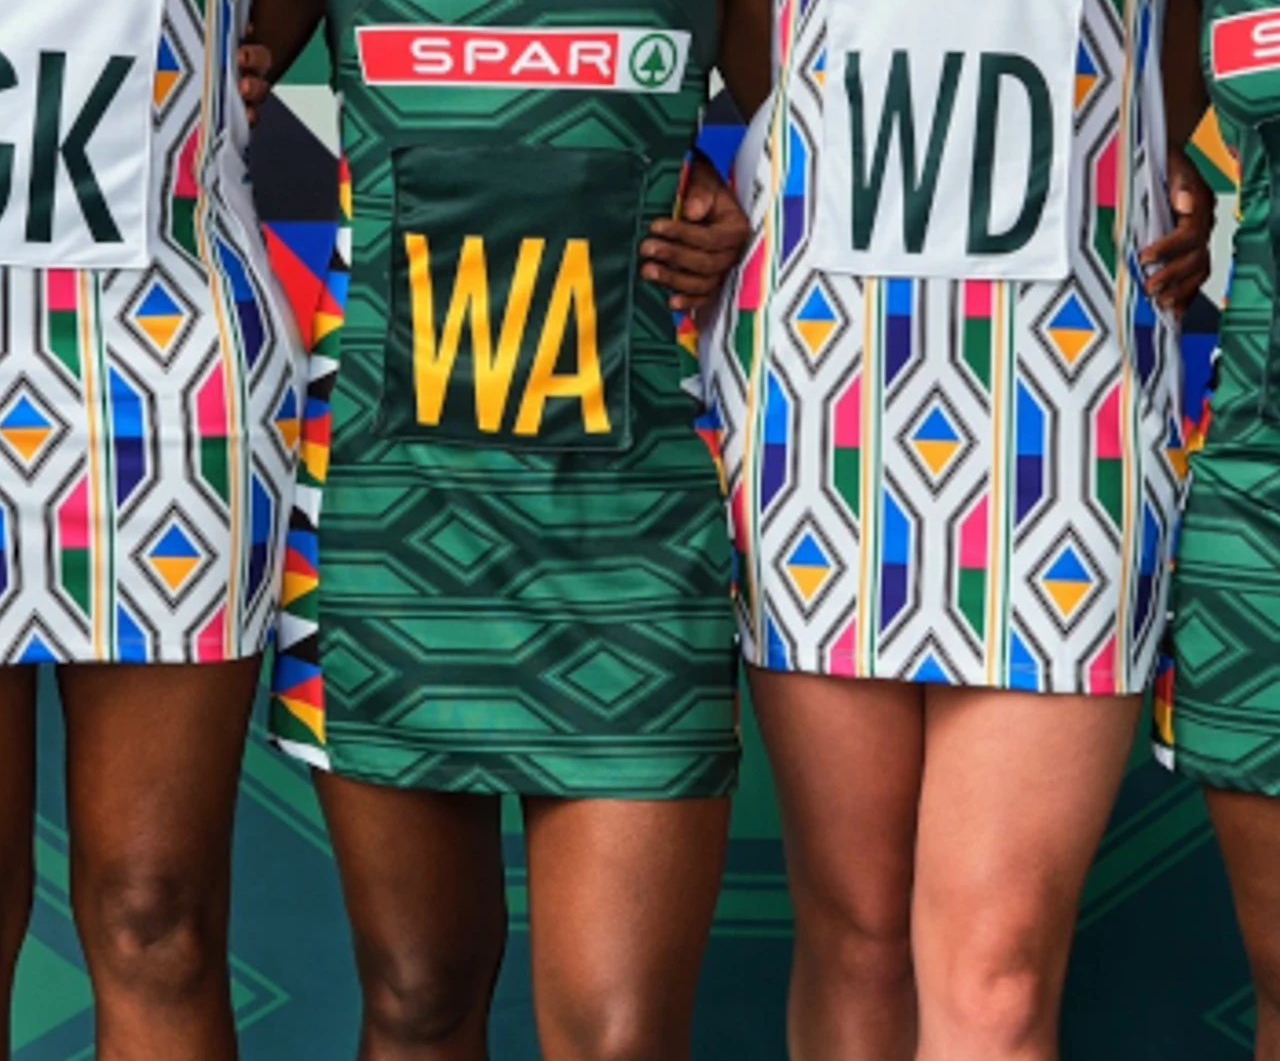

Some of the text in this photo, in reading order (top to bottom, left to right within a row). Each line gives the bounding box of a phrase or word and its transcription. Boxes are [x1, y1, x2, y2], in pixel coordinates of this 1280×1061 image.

[411, 37, 611, 76] SPAR
[844, 50, 1054, 256] WD
[404, 232, 610, 436] WA
